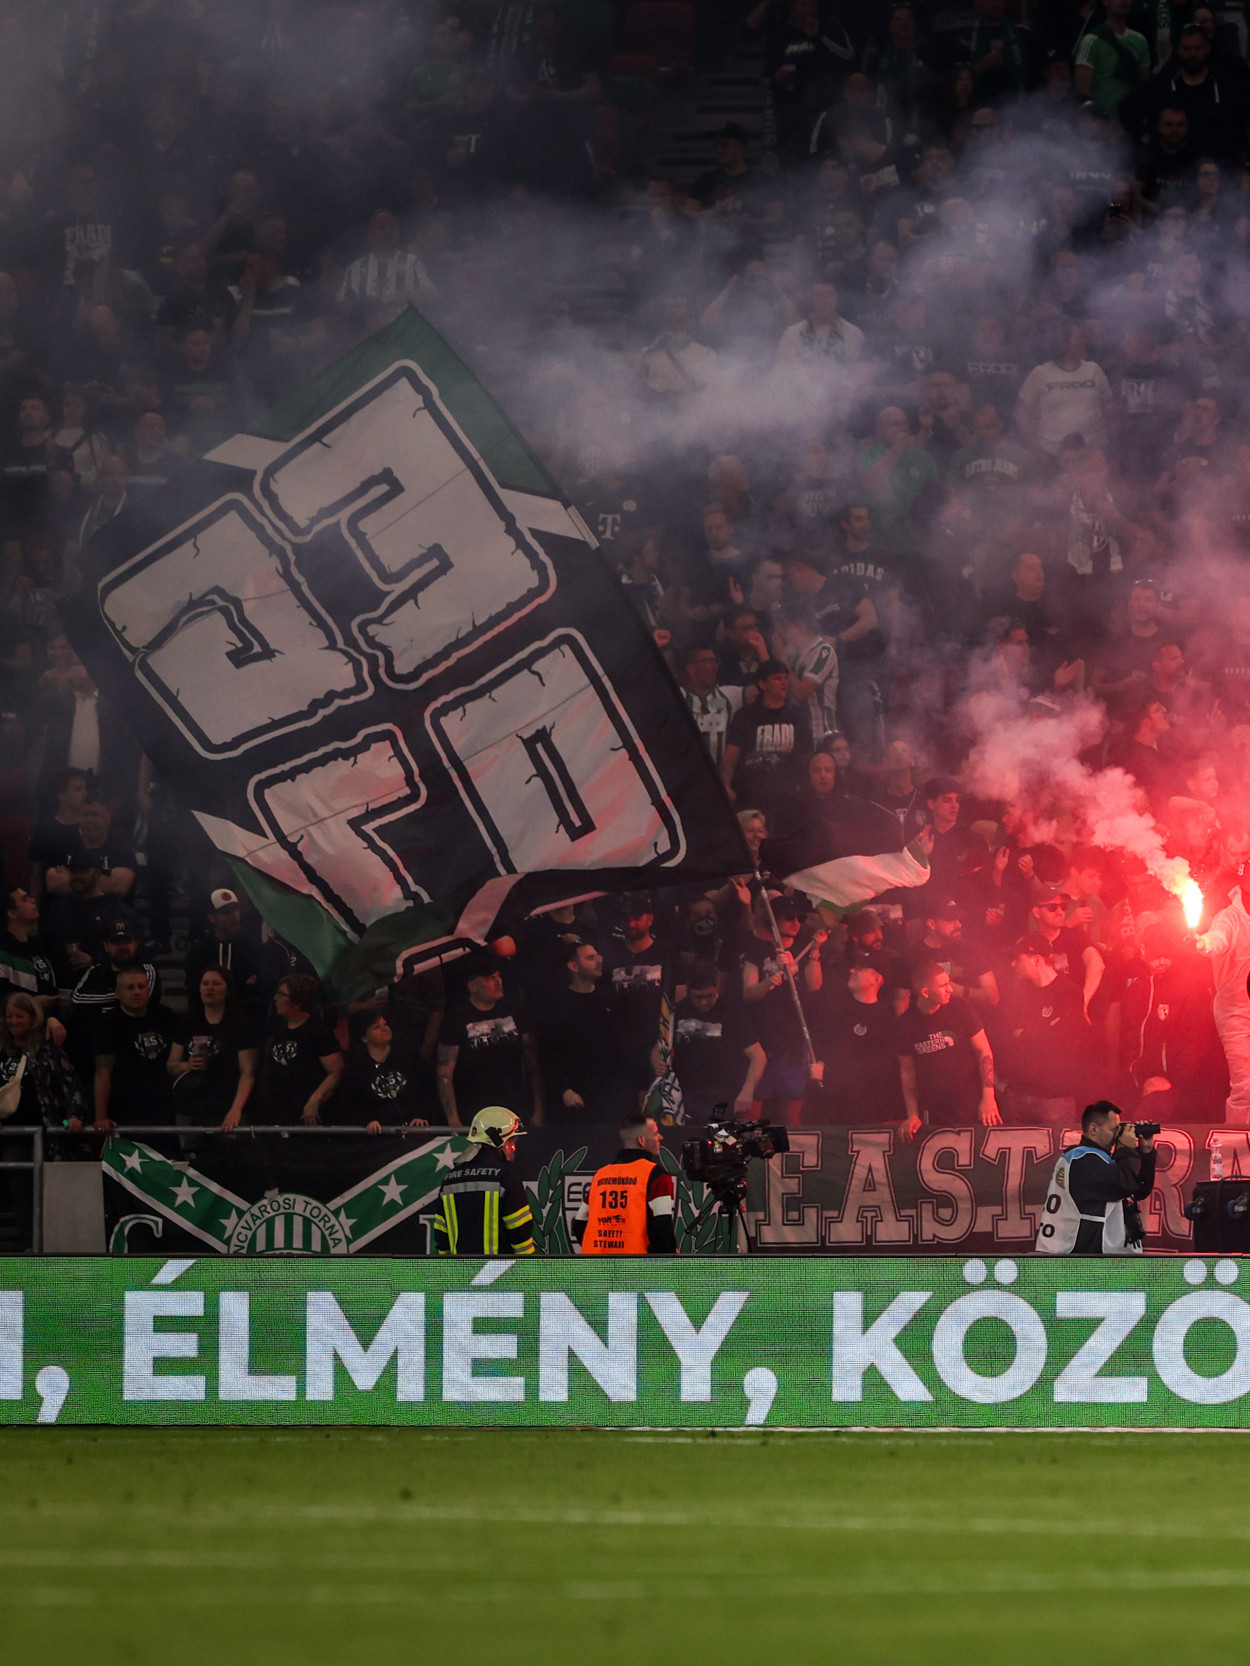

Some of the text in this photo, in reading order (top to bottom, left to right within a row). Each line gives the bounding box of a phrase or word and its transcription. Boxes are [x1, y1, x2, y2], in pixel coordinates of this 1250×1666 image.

[928, 1031, 943, 1041] THE
[444, 1168, 501, 1180] FIRE SAFETY
[600, 1190, 629, 1209] 135
[302, 1200, 342, 1249] TORNA
[597, 1229, 623, 1238] SAFETY
[122, 1259, 779, 1424] ÉLMÉNY,
